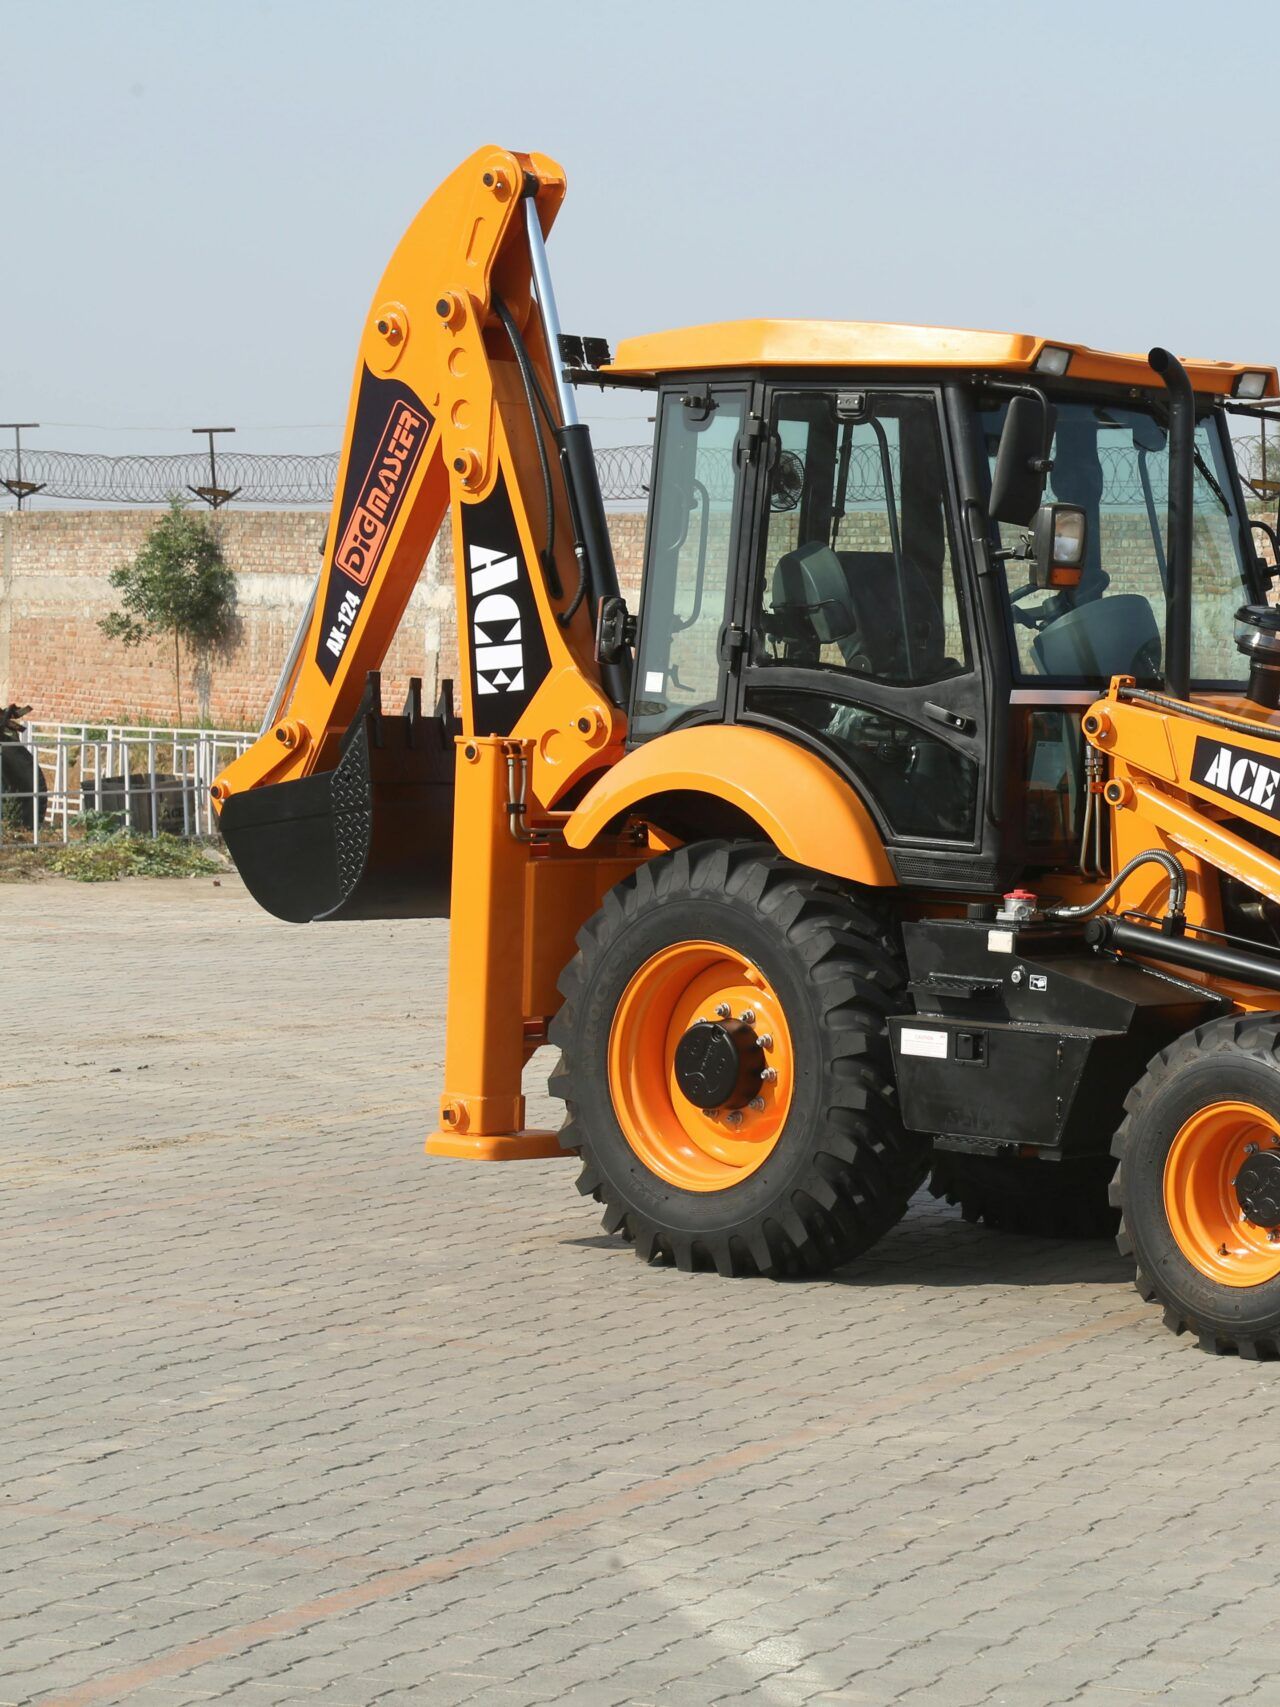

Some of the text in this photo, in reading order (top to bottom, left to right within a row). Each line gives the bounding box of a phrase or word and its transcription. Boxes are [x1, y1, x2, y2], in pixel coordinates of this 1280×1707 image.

[325, 590, 361, 658] AX-124
[469, 544, 525, 695] ACE
[1203, 747, 1280, 811] ACE
